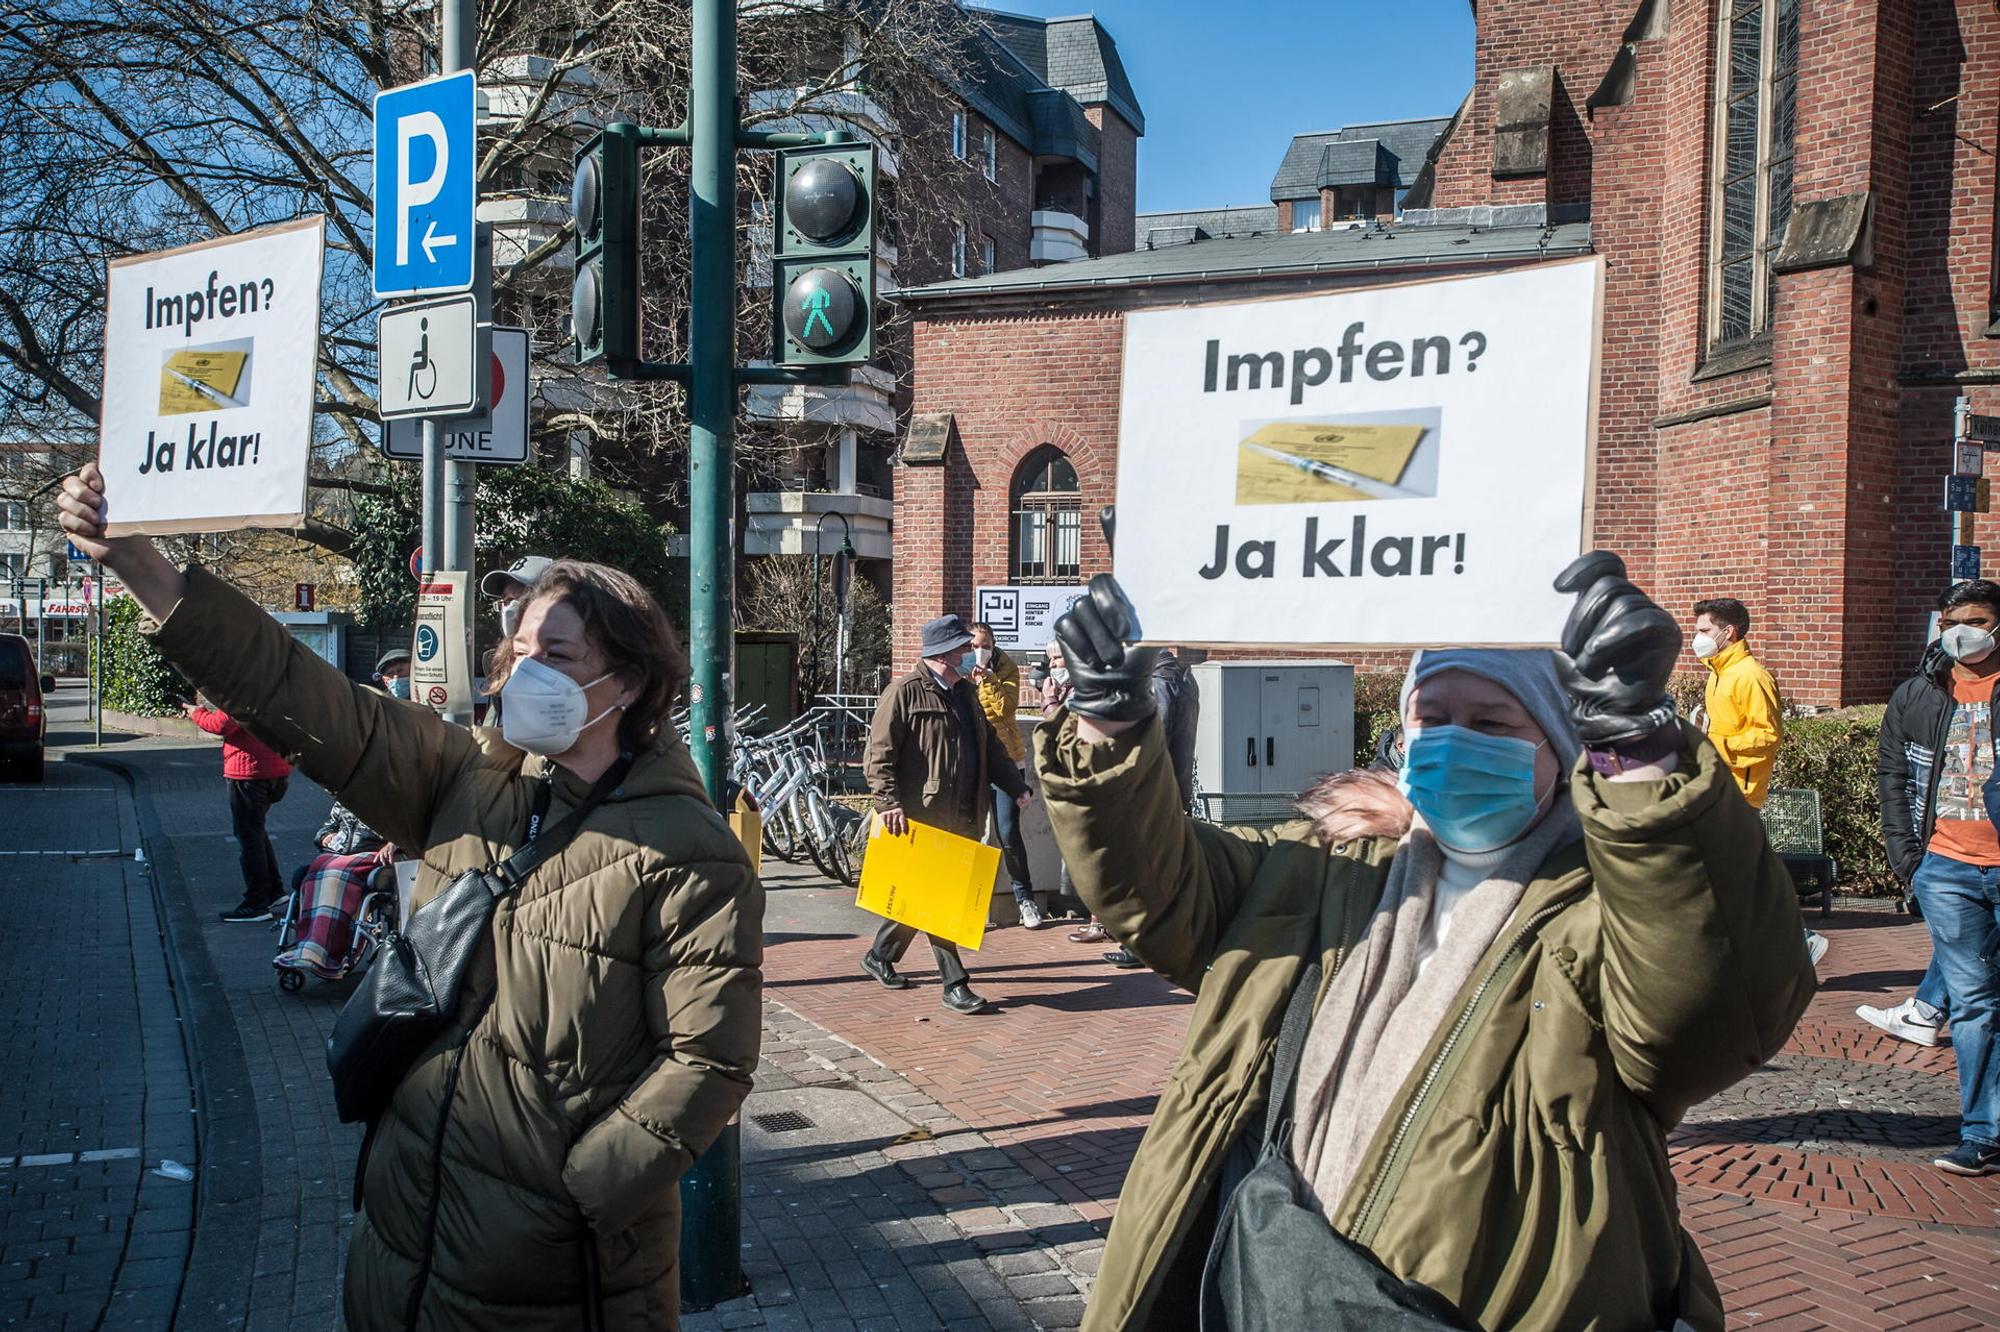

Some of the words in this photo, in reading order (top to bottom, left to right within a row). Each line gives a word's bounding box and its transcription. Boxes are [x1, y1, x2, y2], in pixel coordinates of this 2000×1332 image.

[396, 111, 449, 266] P
[146, 270, 275, 337] Impfen?
[1203, 321, 1488, 406] Impfen?
[138, 431, 176, 475] Ja
[185, 421, 261, 471] klar!
[444, 431, 493, 451] ONE
[1197, 525, 1277, 581] Ja
[1302, 514, 1467, 578] klar!
[529, 814, 540, 840] ONLY
